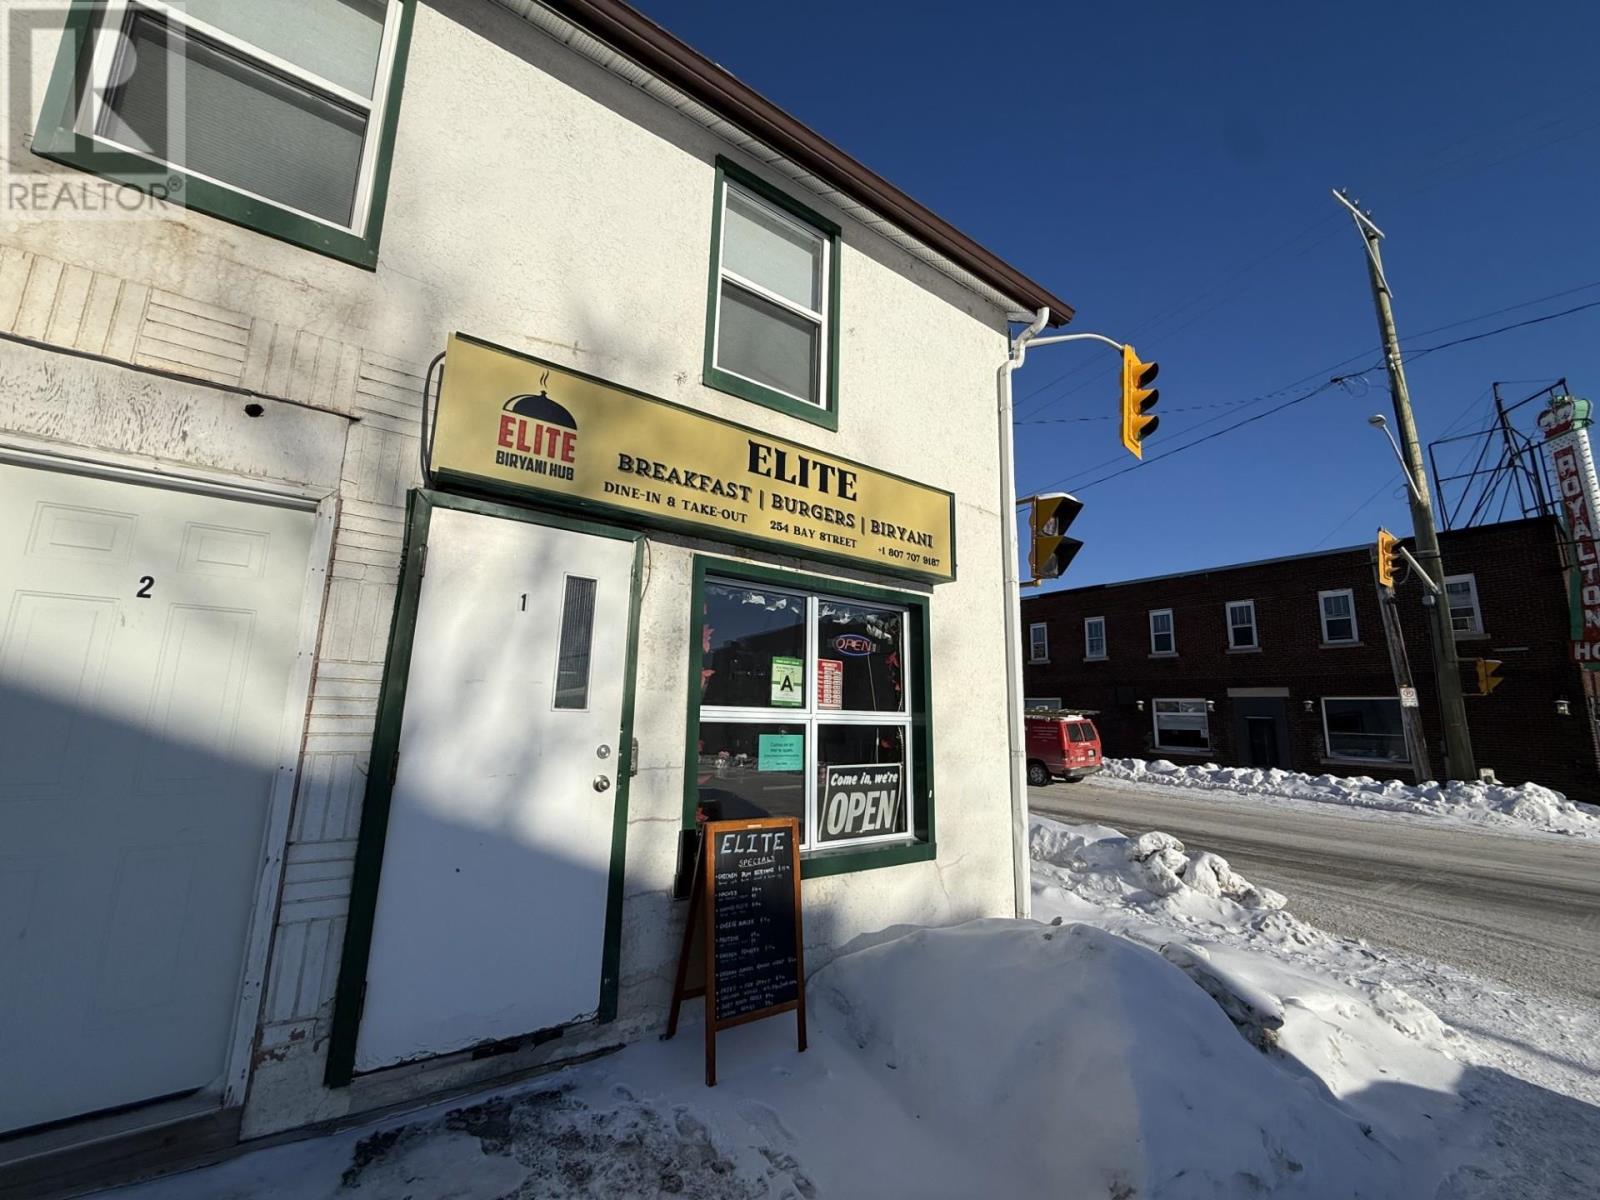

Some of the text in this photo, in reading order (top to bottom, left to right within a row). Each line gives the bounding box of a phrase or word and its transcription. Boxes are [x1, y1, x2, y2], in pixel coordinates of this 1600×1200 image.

[498, 414, 577, 463] ELITE
[496, 450, 574, 481] BIRYANI HUB
[748, 439, 857, 502] ELITE
[604, 481, 748, 524] DINE-IN & TAKE-OUT
[617, 453, 934, 549] BREAKFAST BURGERS BIRYANI
[770, 520, 857, 549] 254 BAY STREET
[1556, 453, 1600, 629] ROYALTON
[888, 548, 904, 559] 807
[906, 552, 920, 562] 707
[136, 575, 155, 599] 2
[519, 592, 528, 612] 1
[835, 638, 872, 651] OPEN
[780, 675, 794, 692] A
[830, 771, 898, 786] Come in, we're
[827, 789, 896, 835] OPEN
[720, 831, 785, 854] ELITE
